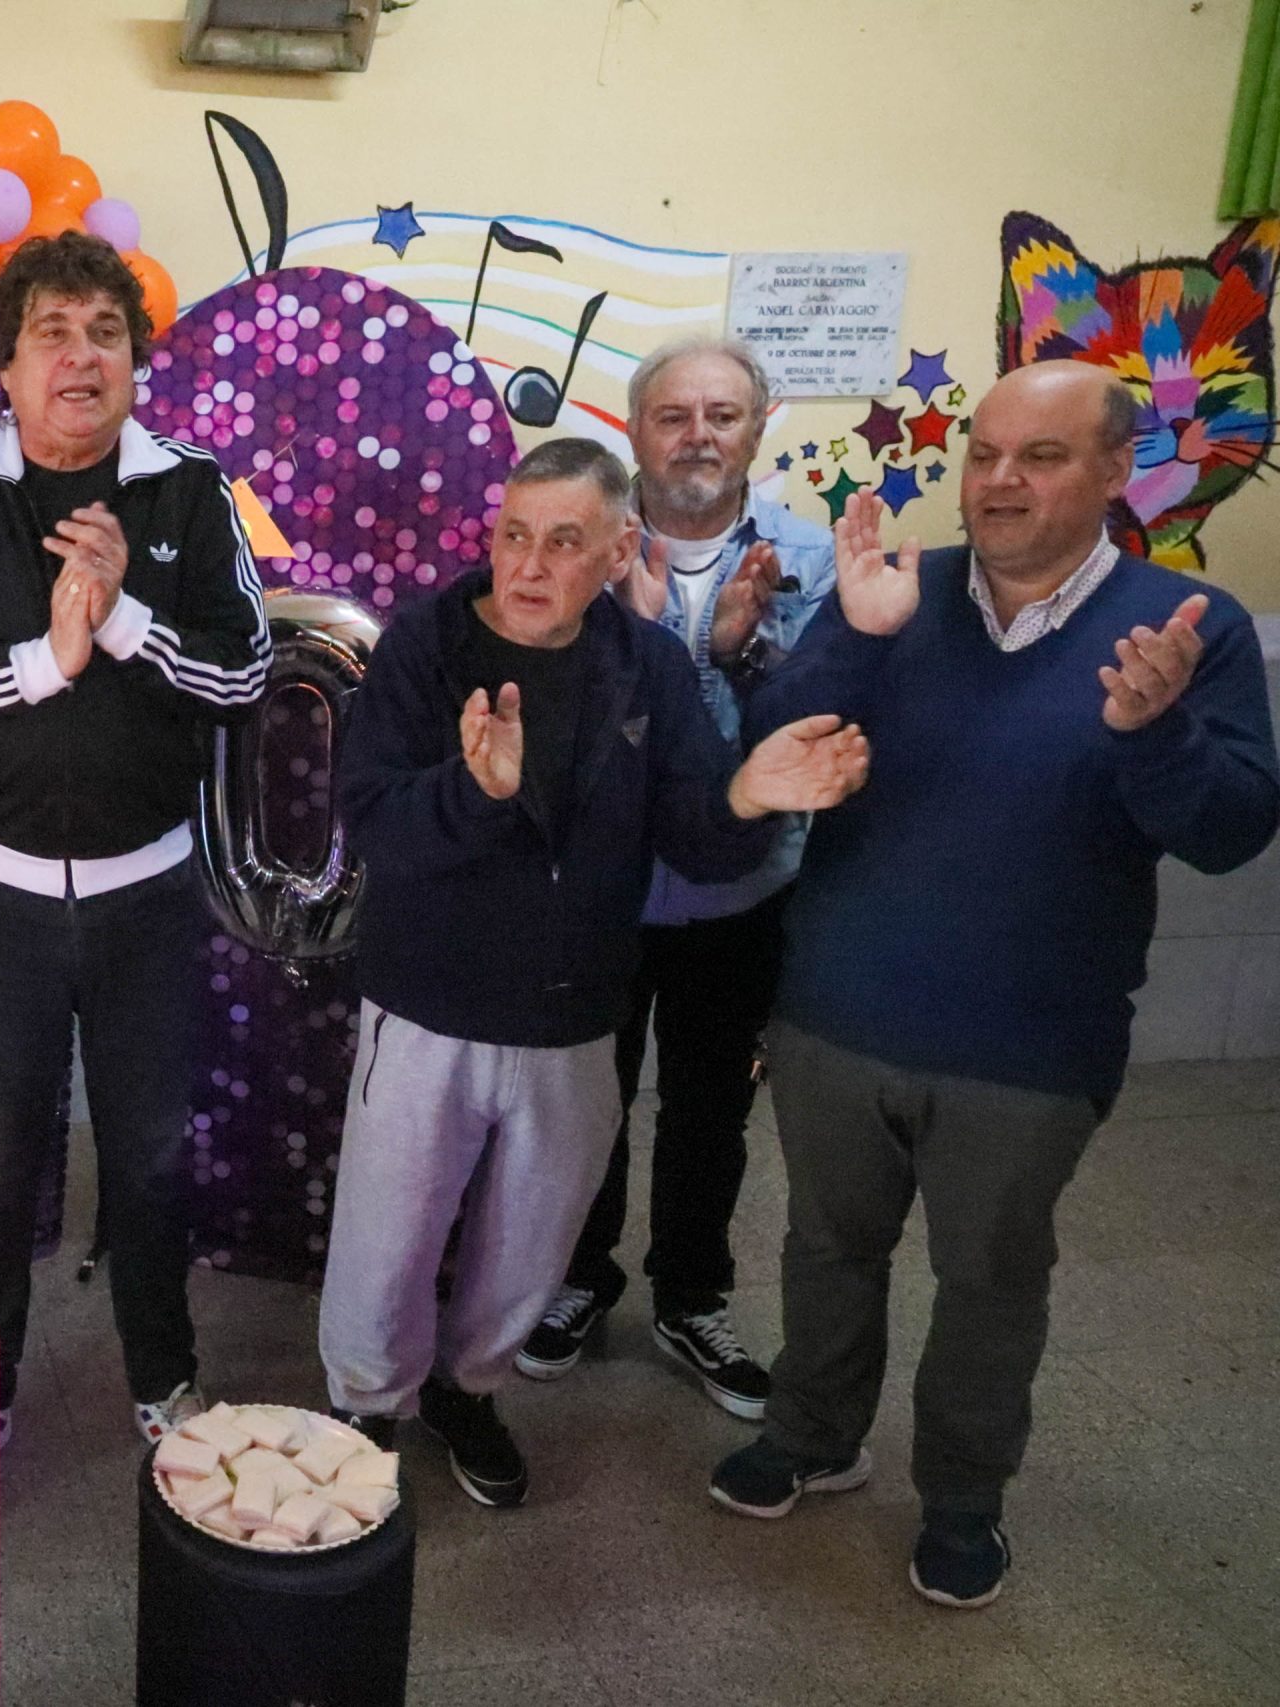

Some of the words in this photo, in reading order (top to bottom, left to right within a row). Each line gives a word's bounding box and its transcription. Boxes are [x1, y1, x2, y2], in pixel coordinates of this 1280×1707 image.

[773, 277, 810, 288] BARRIO
[812, 277, 866, 288] ARGENTINA
[775, 349, 786, 358] DE
[788, 349, 824, 358] OCTUBRE
[827, 349, 837, 358] DE
